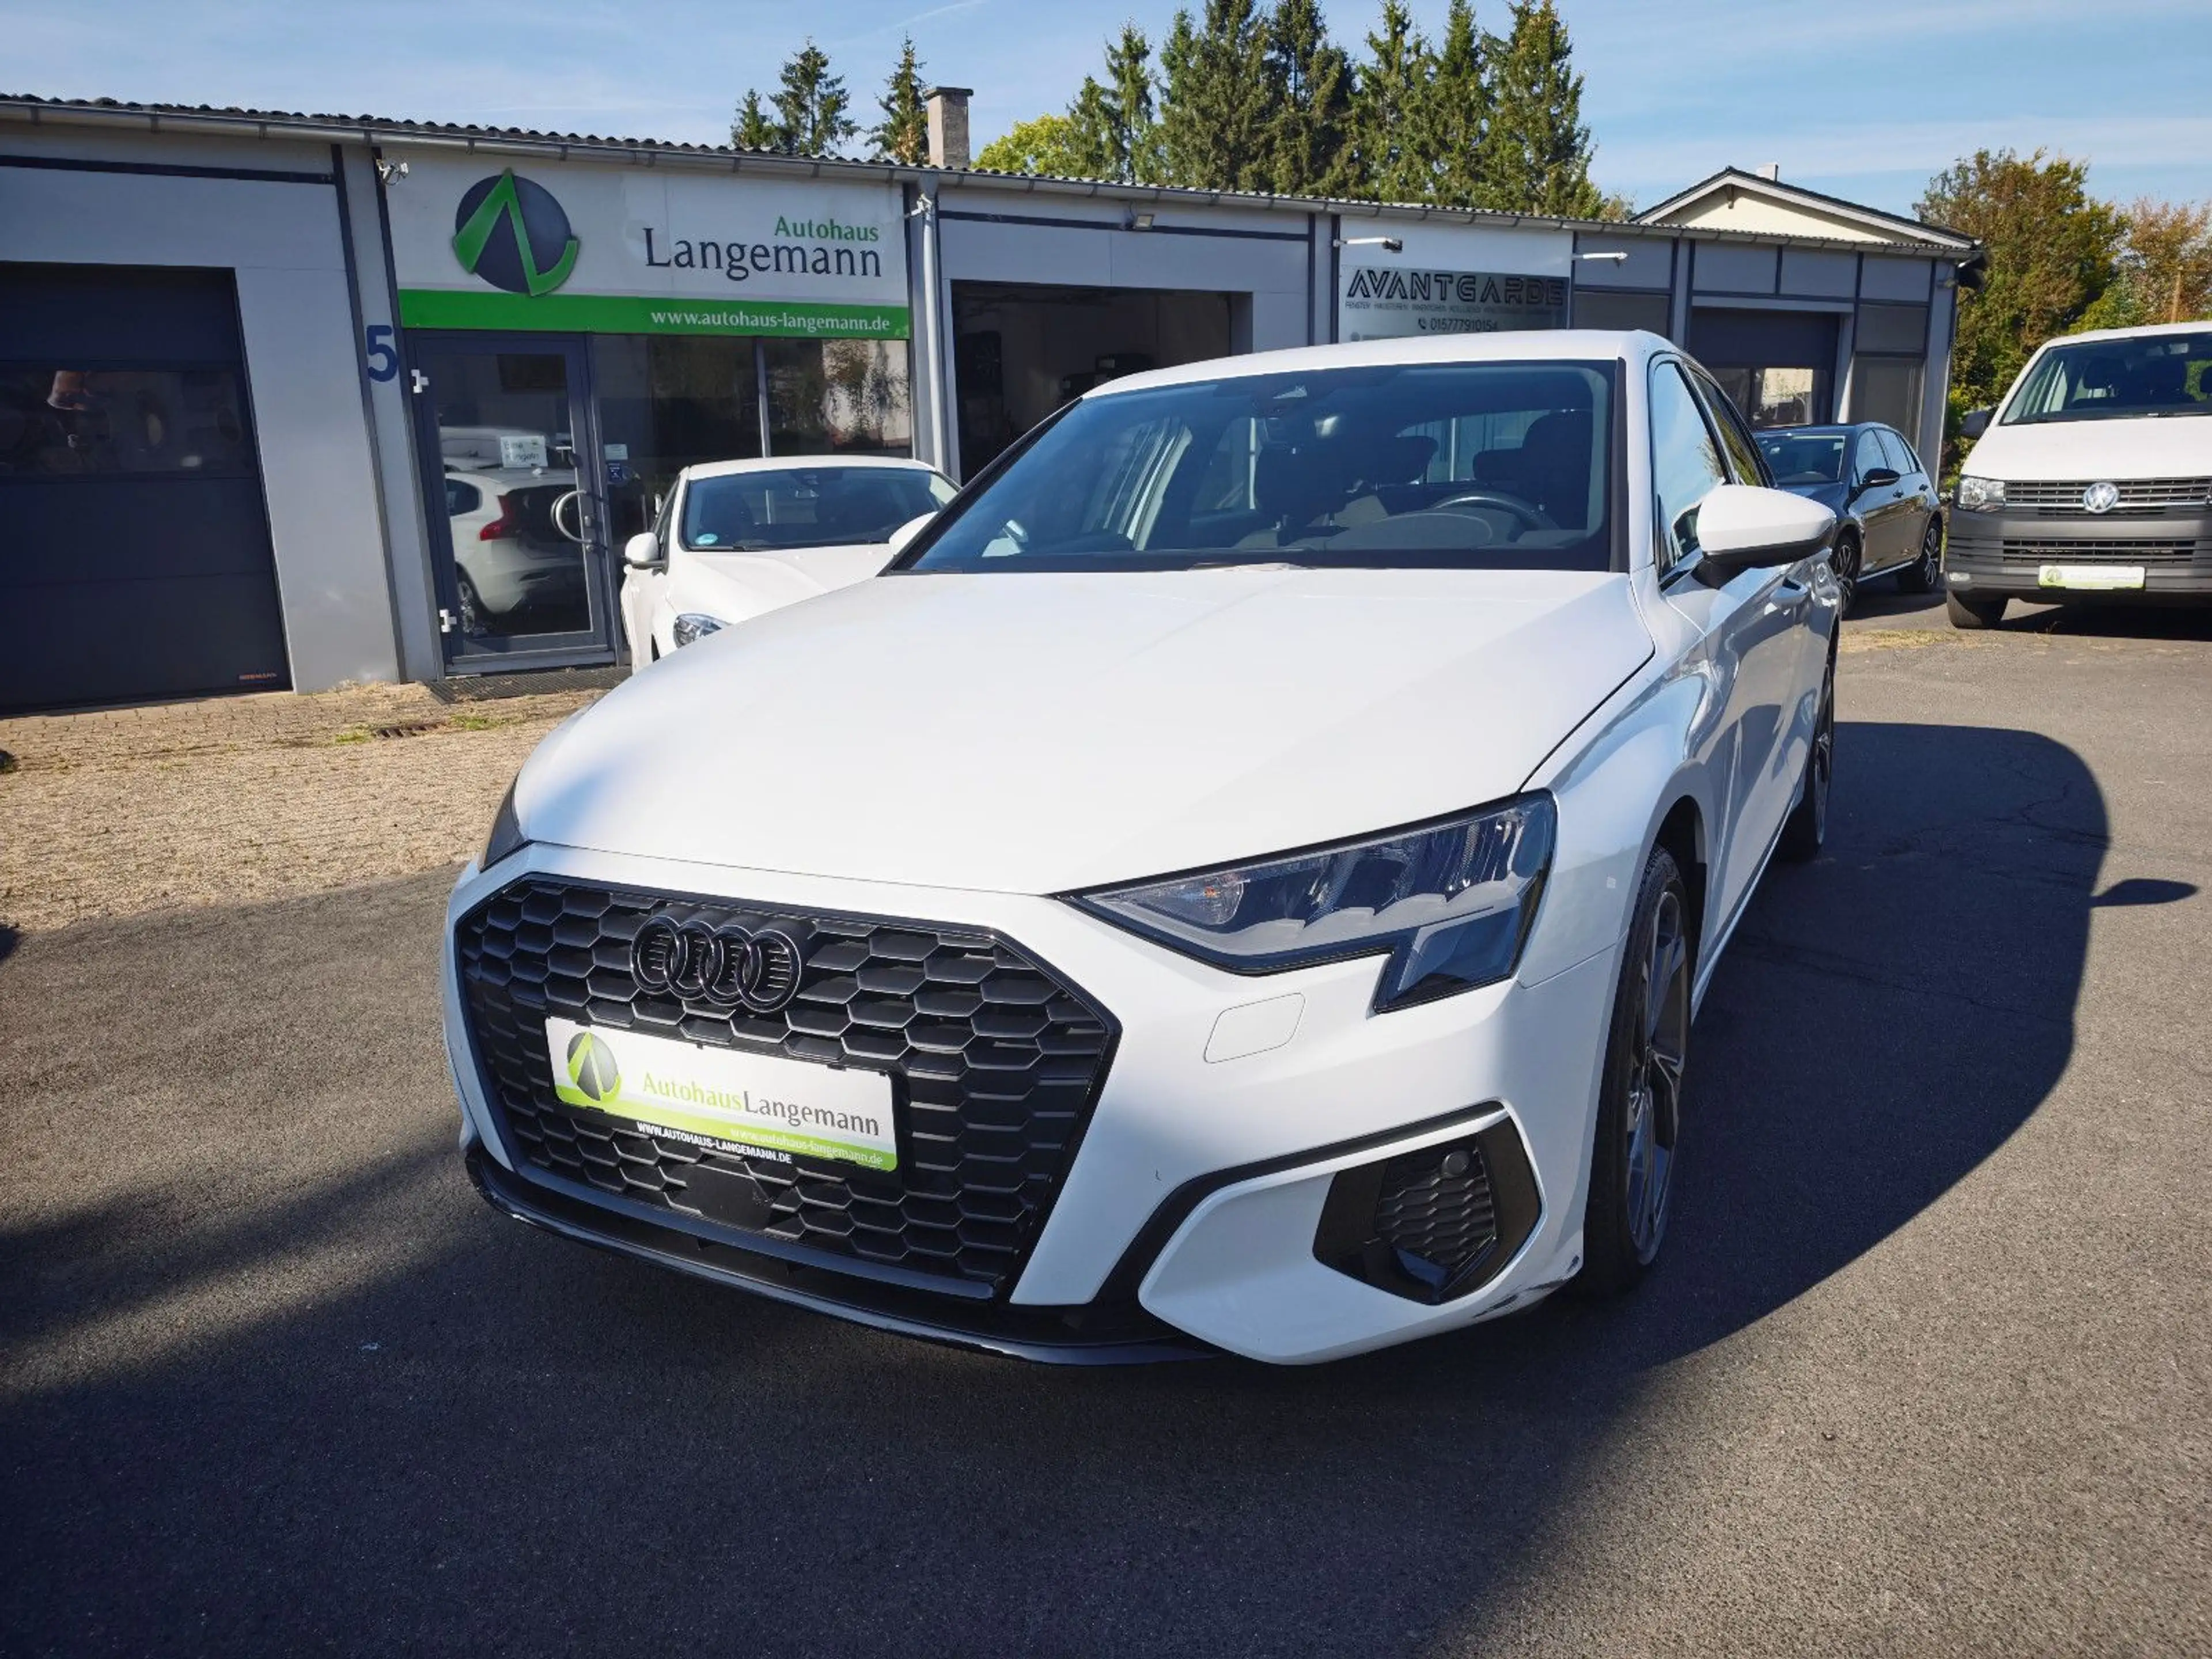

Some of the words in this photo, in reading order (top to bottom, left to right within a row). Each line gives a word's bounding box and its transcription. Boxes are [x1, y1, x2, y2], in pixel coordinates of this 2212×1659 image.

[774, 215, 880, 242] Autohaus
[642, 228, 882, 282] Langemann
[1347, 269, 1564, 308] AVANTGARDE
[651, 309, 891, 332] www.autohaus-langemann.de
[365, 324, 398, 382] 5
[636, 1122, 793, 1164] WWW.AUTOHAUS-LANGEMANN.DE
